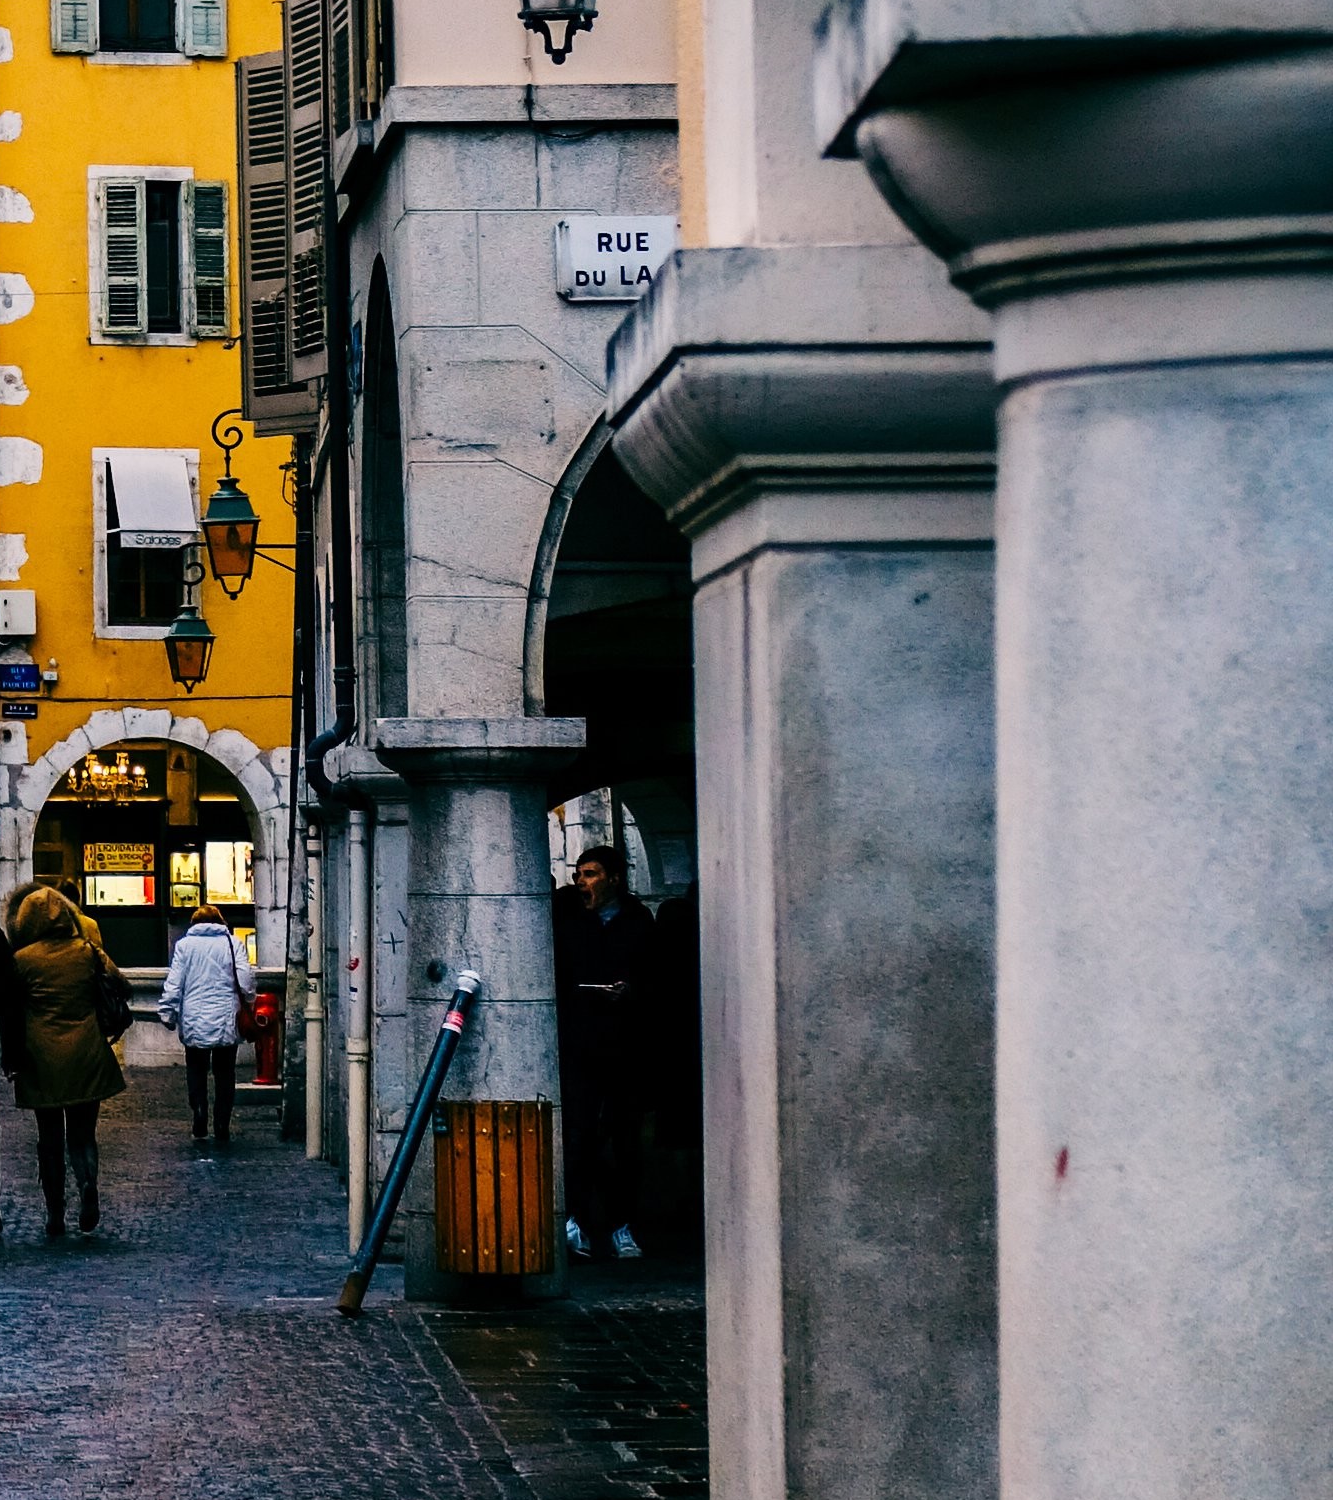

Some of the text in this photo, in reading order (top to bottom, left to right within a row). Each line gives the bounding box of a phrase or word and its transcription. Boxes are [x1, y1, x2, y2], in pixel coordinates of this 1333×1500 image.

[598, 232, 649, 252] RUE
[576, 270, 606, 286] DU
[135, 534, 181, 545] Salades
[98, 844, 150, 852] LIQUIDATION
